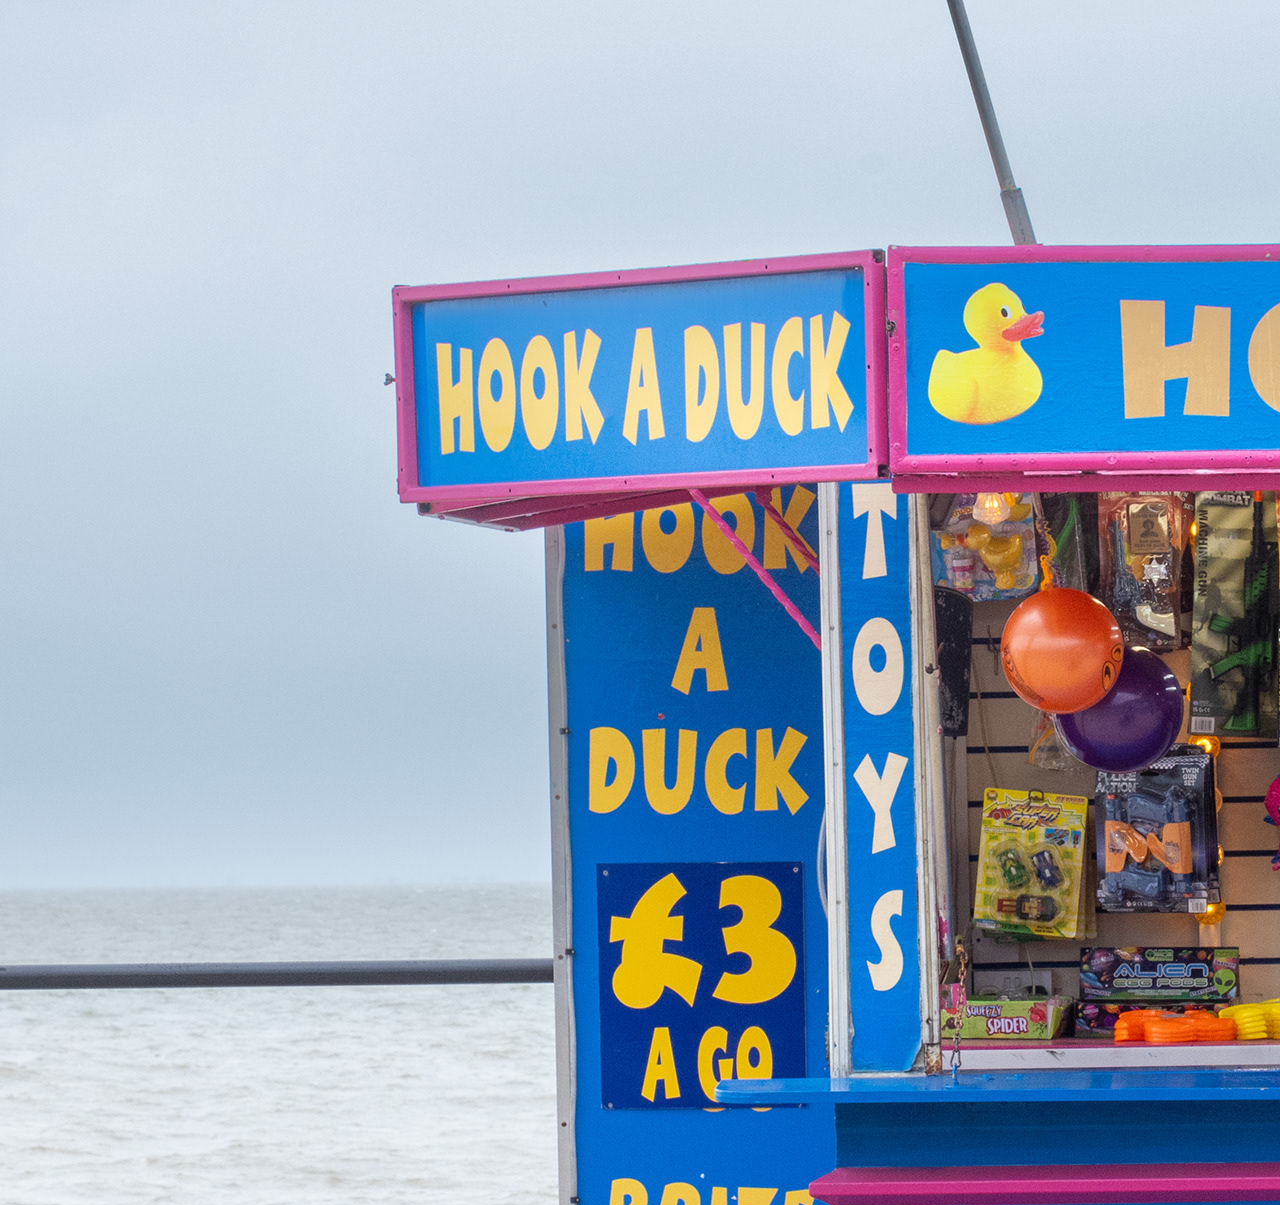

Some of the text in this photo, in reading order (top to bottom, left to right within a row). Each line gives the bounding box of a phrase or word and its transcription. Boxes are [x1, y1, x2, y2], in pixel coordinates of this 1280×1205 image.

[435, 310, 854, 455] HOOK A DUCK
[583, 484, 818, 575] HOOK
[1198, 510, 1208, 597] MACHINE GUN
[671, 607, 729, 695] A
[588, 726, 809, 816] DUCK
[851, 483, 909, 992] TOYS
[1014, 802, 1061, 822] SUPER
[609, 872, 797, 1009] £3
[1113, 963, 1209, 977] ALIEN
[1113, 978, 1209, 988] EGG PODS
[966, 1004, 1003, 1018] SQUEEZY
[986, 1016, 1029, 1036] SPIDER
[640, 1025, 774, 1112] A GO
